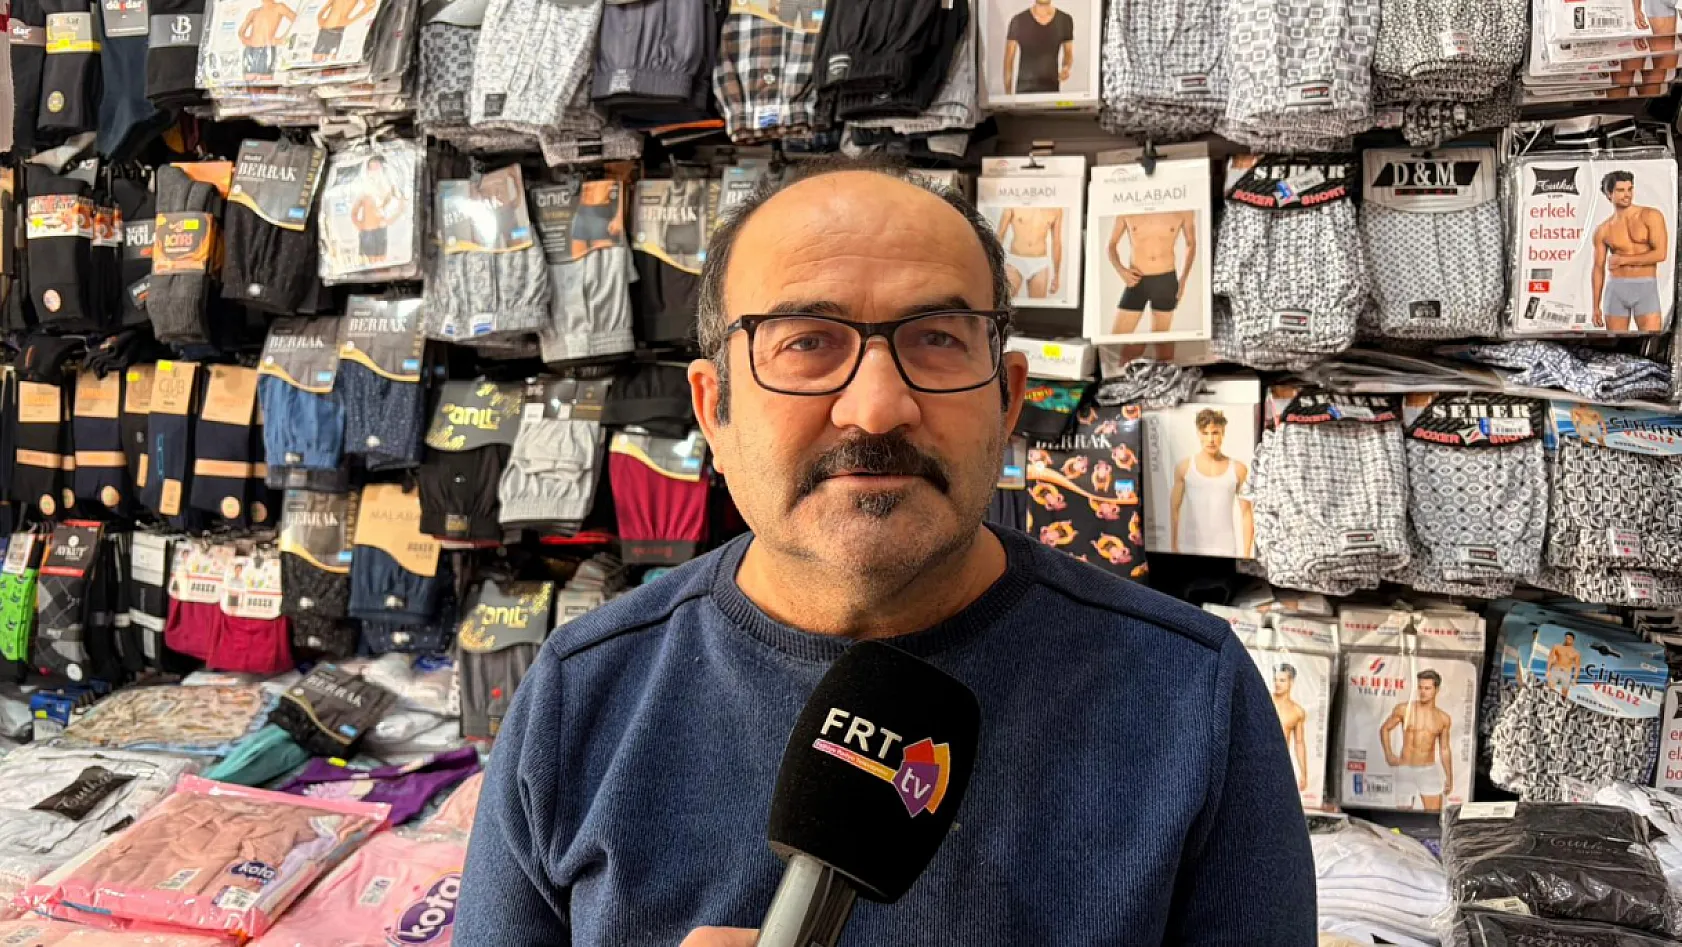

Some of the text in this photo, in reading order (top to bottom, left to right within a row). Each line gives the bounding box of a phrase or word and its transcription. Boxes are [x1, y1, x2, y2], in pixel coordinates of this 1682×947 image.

[237, 162, 297, 182] BERRAK
[1112, 185, 1186, 204] MALABADİ
[1301, 187, 1346, 207] SHORT
[1529, 203, 1576, 218] erkek
[1528, 247, 1575, 262] boxer
[1532, 282, 1545, 291] XL
[1431, 402, 1532, 419] SEHER
[1413, 427, 1461, 444] BOXER
[1350, 676, 1407, 690] SEHER
[820, 707, 902, 759] FRT
[901, 767, 931, 799] tv
